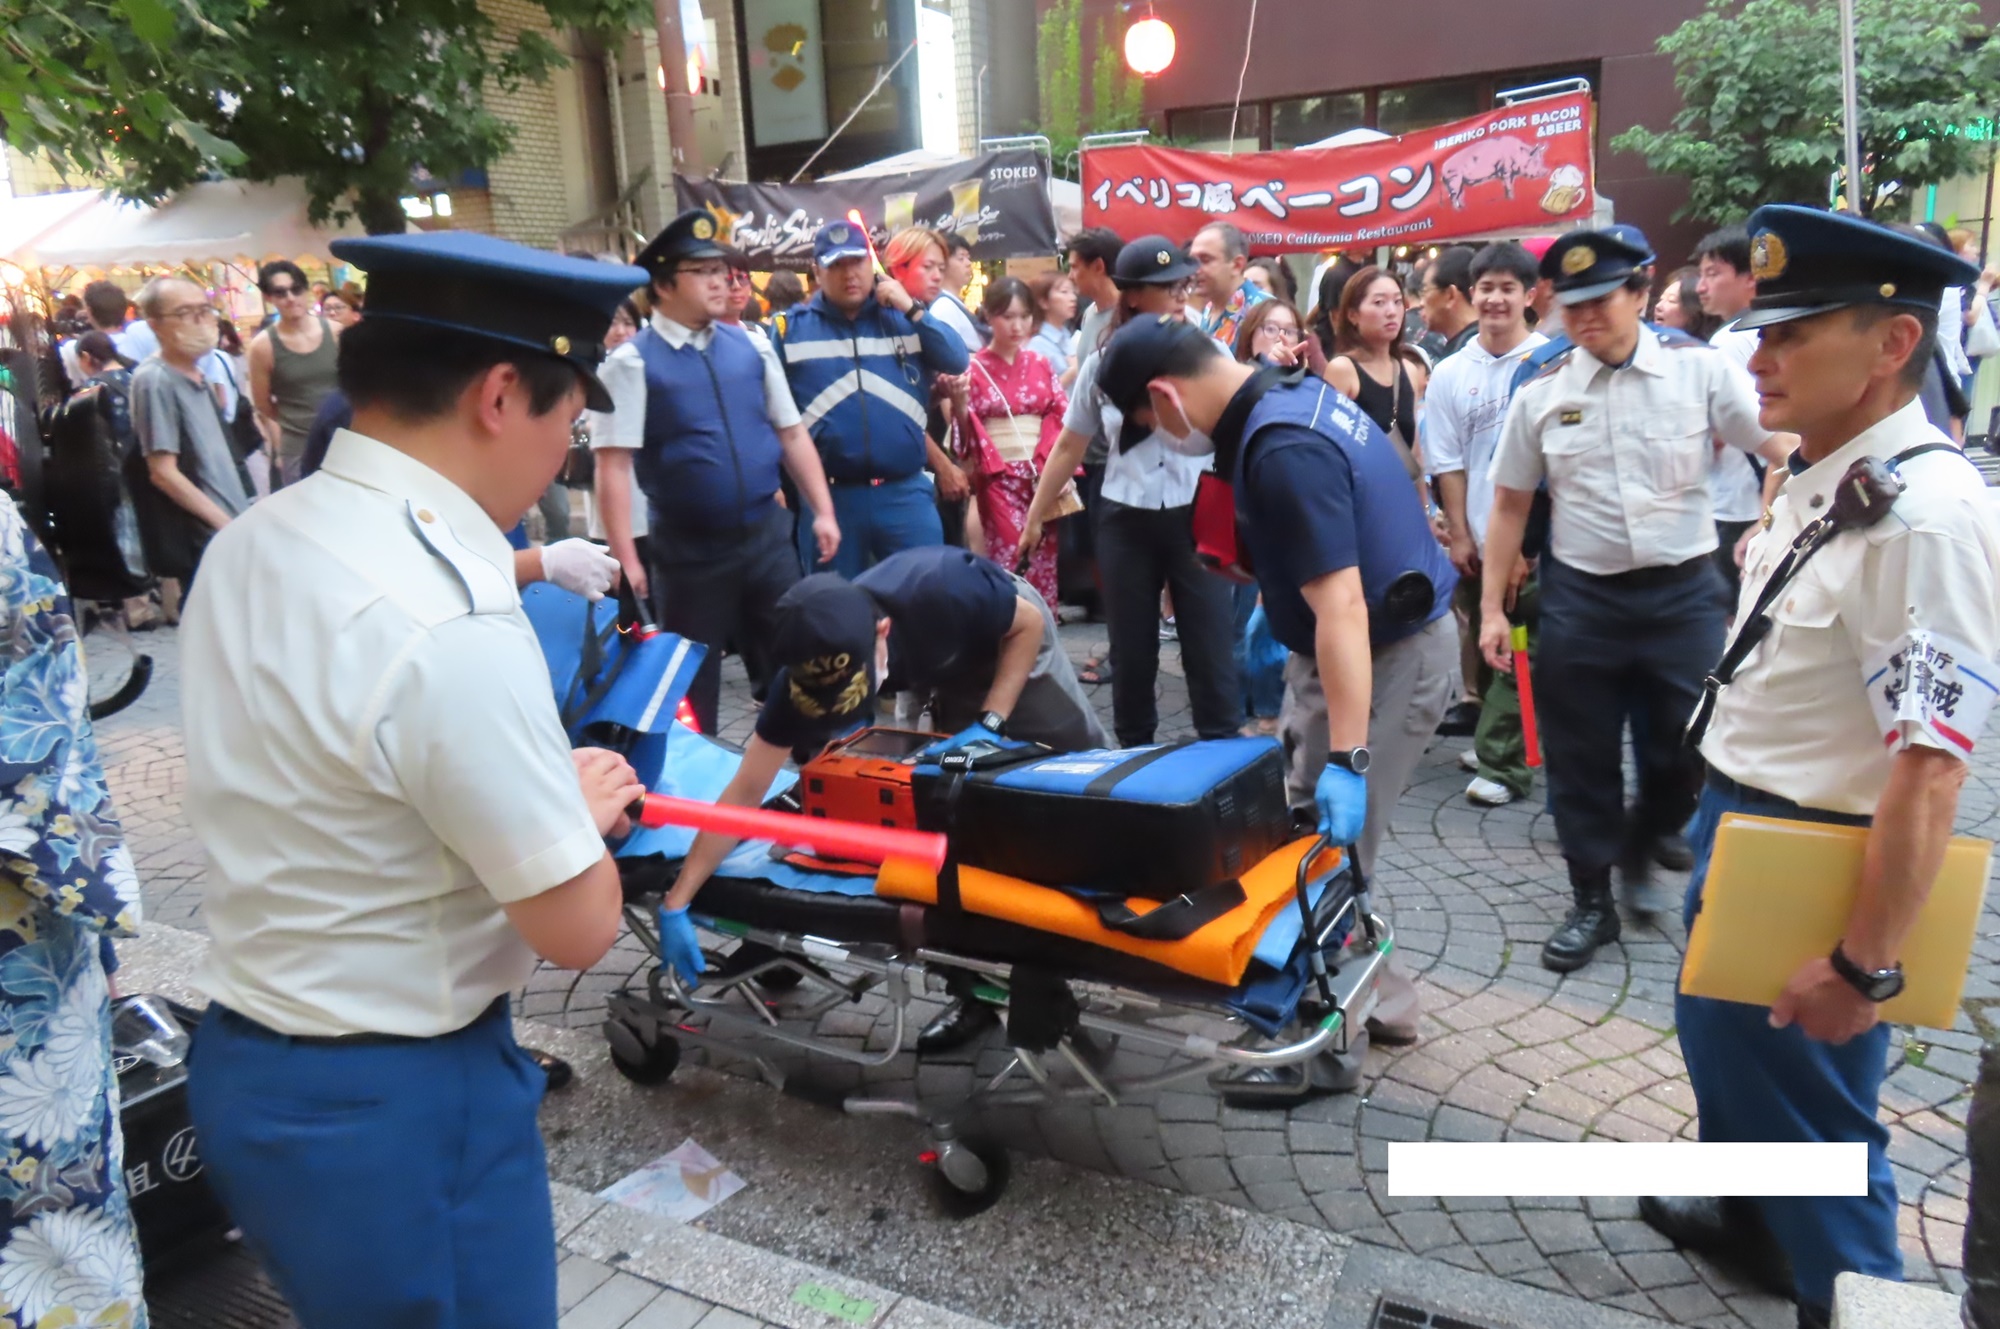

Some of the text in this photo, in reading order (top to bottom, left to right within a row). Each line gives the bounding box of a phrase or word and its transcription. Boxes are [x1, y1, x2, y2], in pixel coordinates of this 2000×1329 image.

[1434, 106, 1580, 150] IBERIKO PORK BACON
[1537, 119, 1581, 138] &BEER
[990, 166, 1037, 180] STOKED
[731, 208, 825, 255] Garlic Shri
[1249, 217, 1434, 245] OKED California Restaurant
